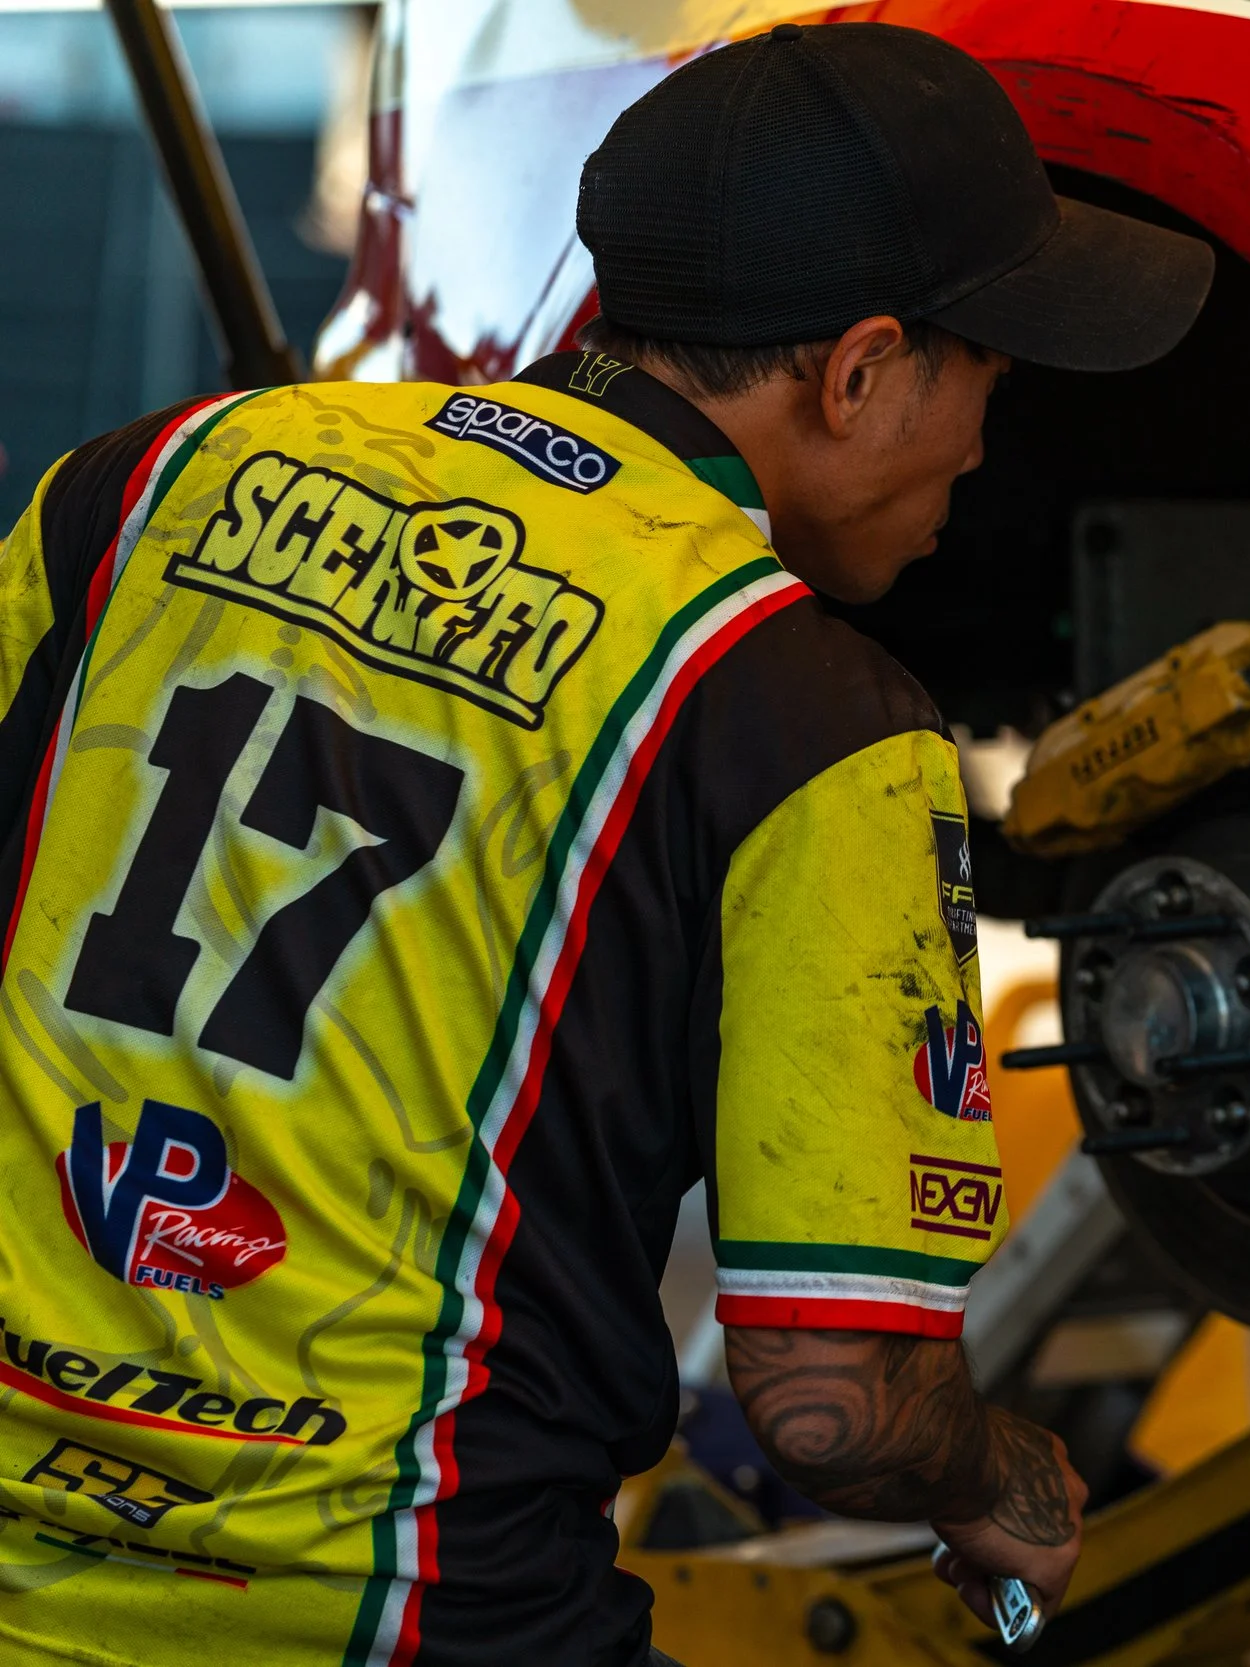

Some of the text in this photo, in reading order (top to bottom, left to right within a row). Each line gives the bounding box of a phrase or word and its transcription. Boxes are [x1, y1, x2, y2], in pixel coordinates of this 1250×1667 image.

[568, 351, 635, 397] 17
[446, 397, 606, 484] sparco
[63, 671, 465, 1082] 17
[924, 999, 982, 1120] VP
[963, 1106, 993, 1123] FUEL
[71, 1098, 227, 1286] VP
[910, 1169, 1003, 1226] NEXEN
[140, 1210, 287, 1267] Racing
[134, 1264, 225, 1301] FUELS
[0, 1316, 348, 1447] uelTech
